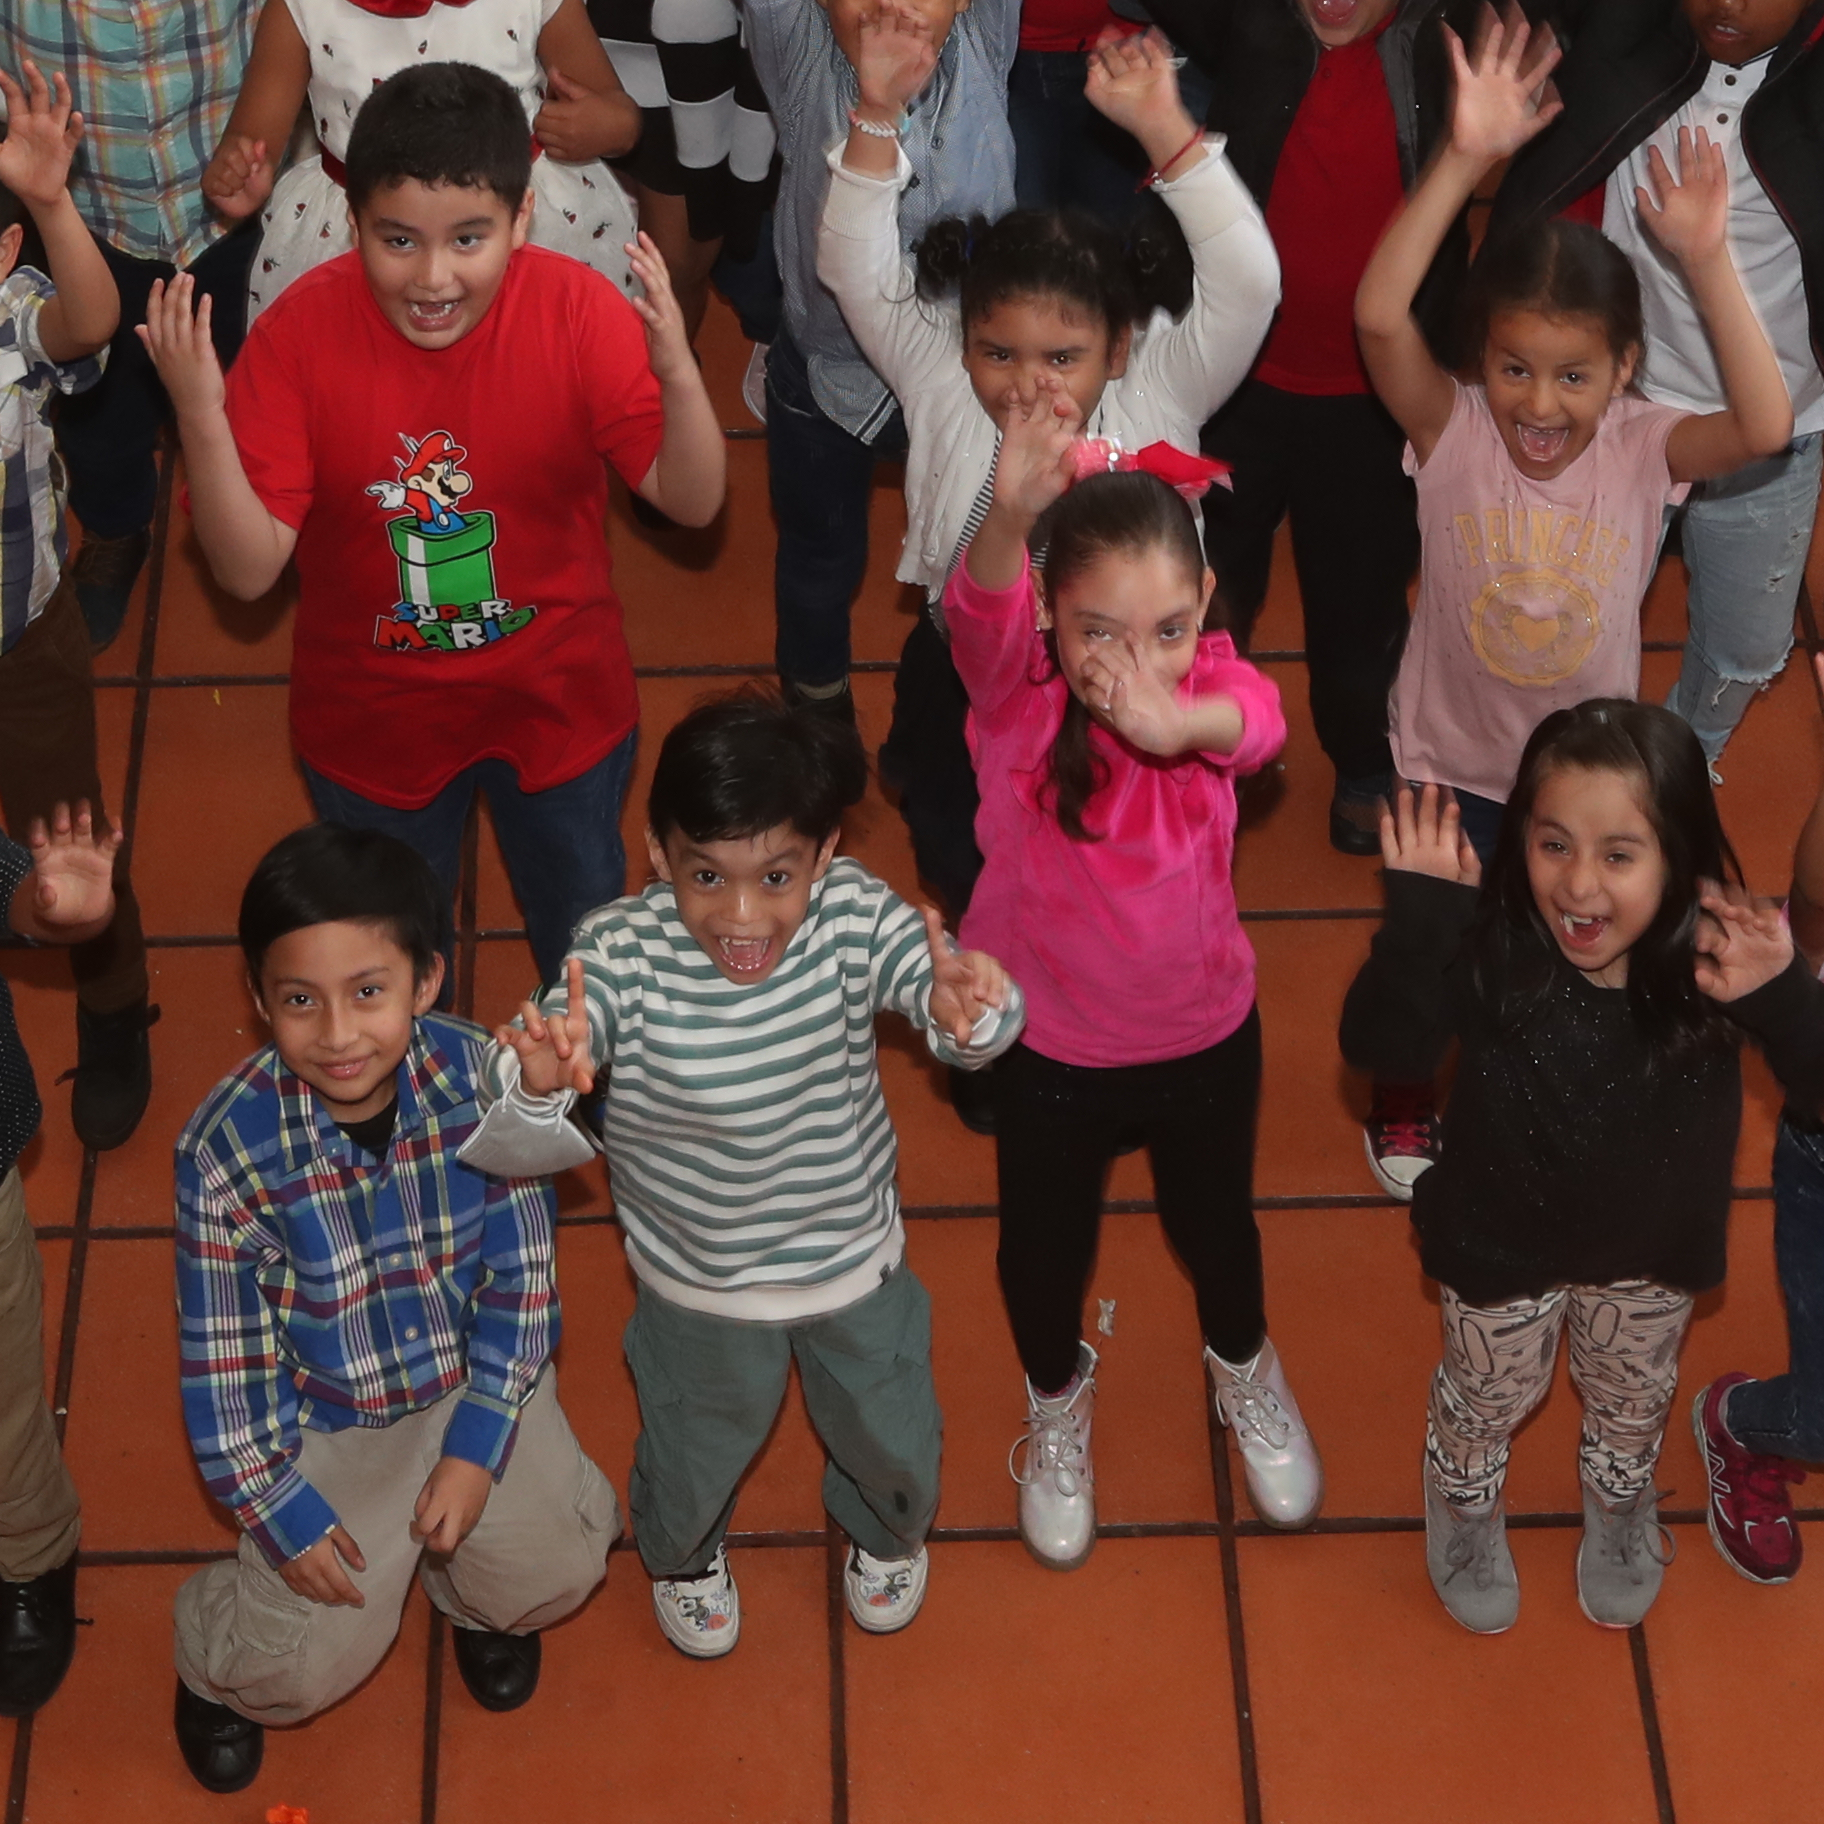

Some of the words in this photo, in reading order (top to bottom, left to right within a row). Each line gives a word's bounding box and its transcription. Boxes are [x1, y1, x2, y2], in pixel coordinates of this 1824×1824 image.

[1454, 508, 1631, 588] PRINCESS
[375, 605, 538, 652] MARIO
[393, 599, 513, 623] SUPER
